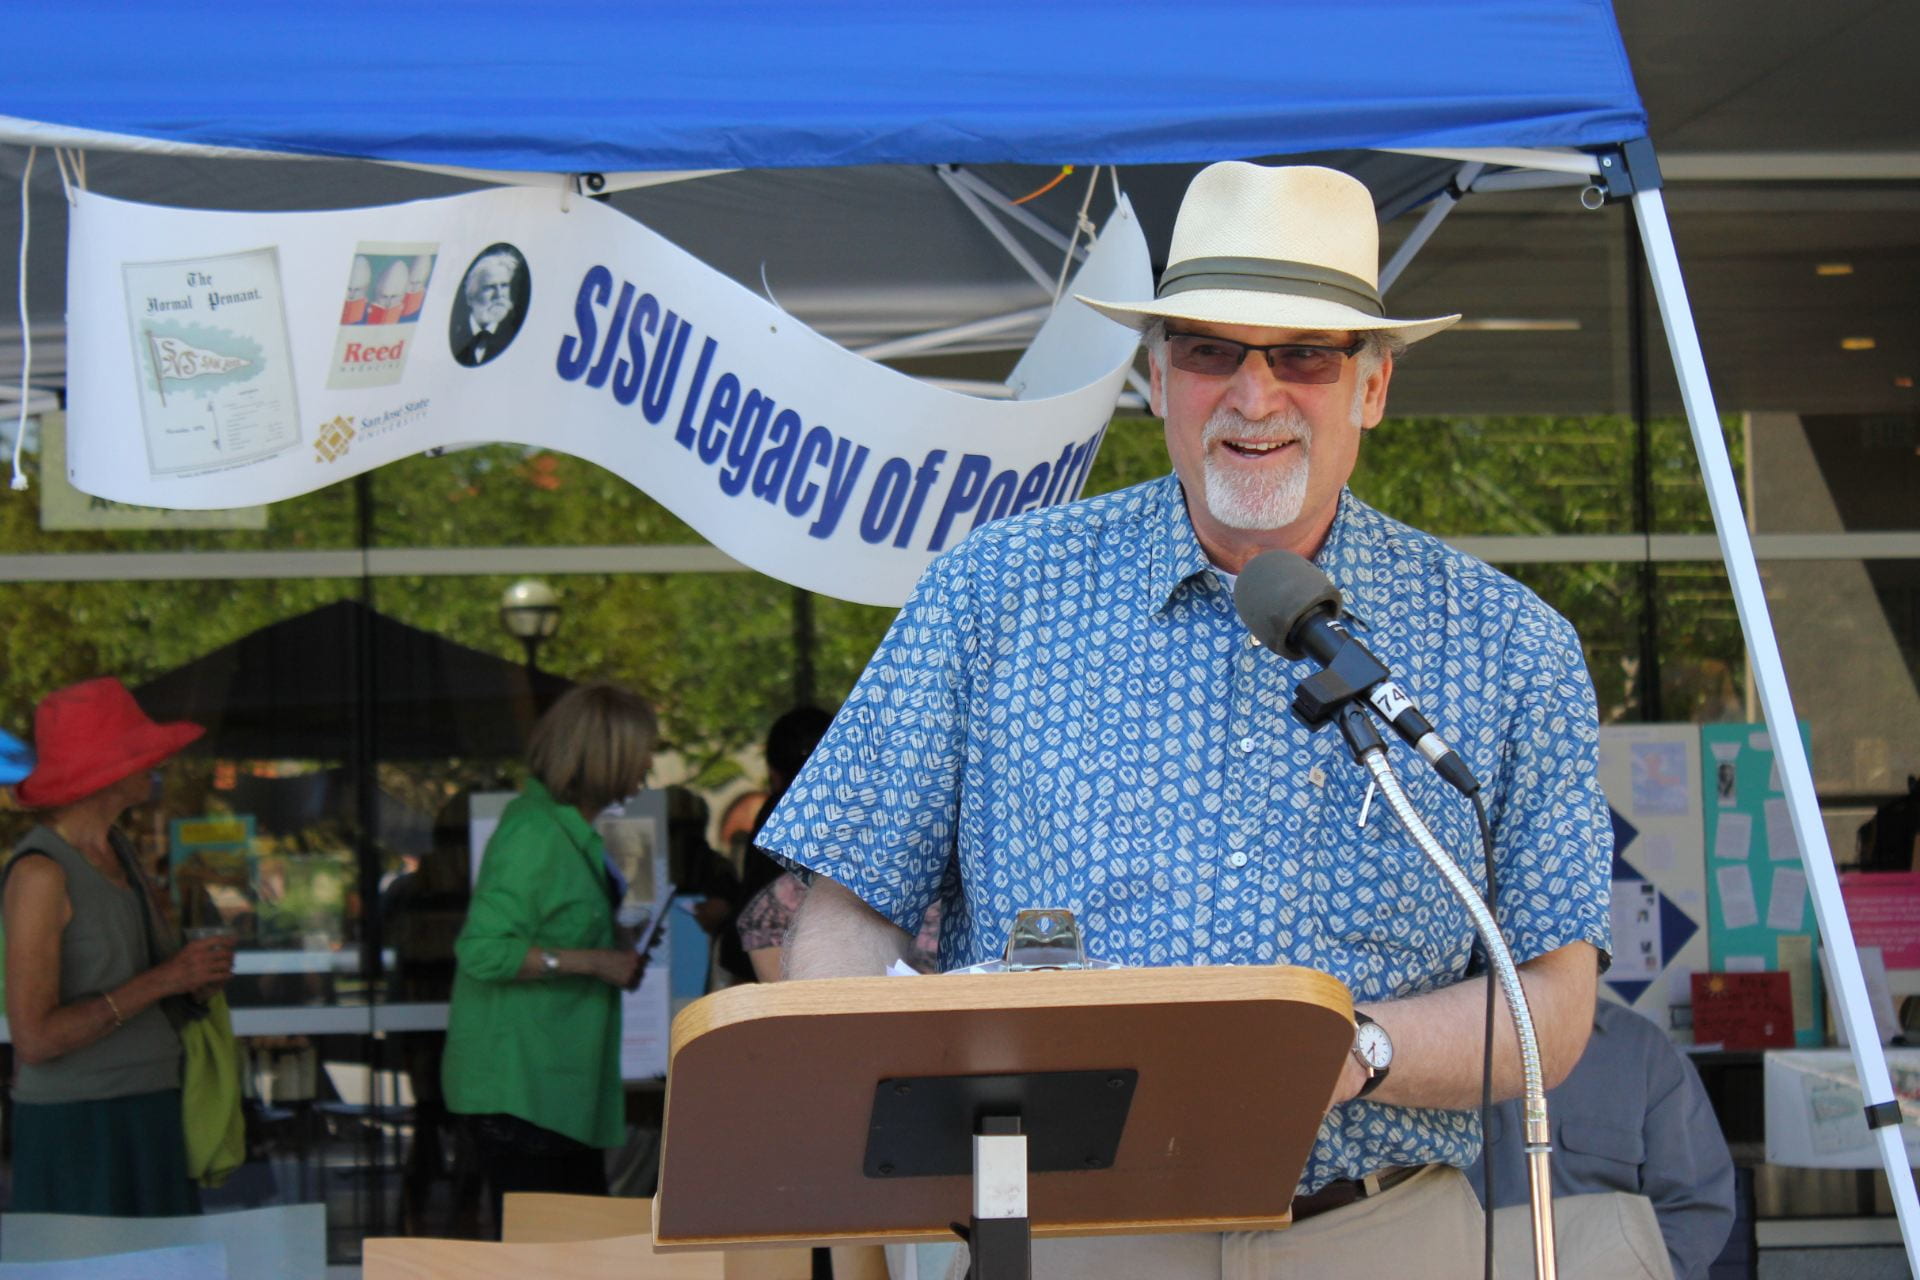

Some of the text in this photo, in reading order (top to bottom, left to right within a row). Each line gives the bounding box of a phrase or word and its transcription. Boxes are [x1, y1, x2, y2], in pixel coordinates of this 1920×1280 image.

[186, 271, 213, 288] The
[146, 295, 193, 313] Normal
[343, 339, 405, 363] Reed
[556, 265, 692, 425] SJSU
[674, 336, 870, 539] Legacy
[859, 450, 947, 549] of
[1377, 687, 1407, 713] 74
